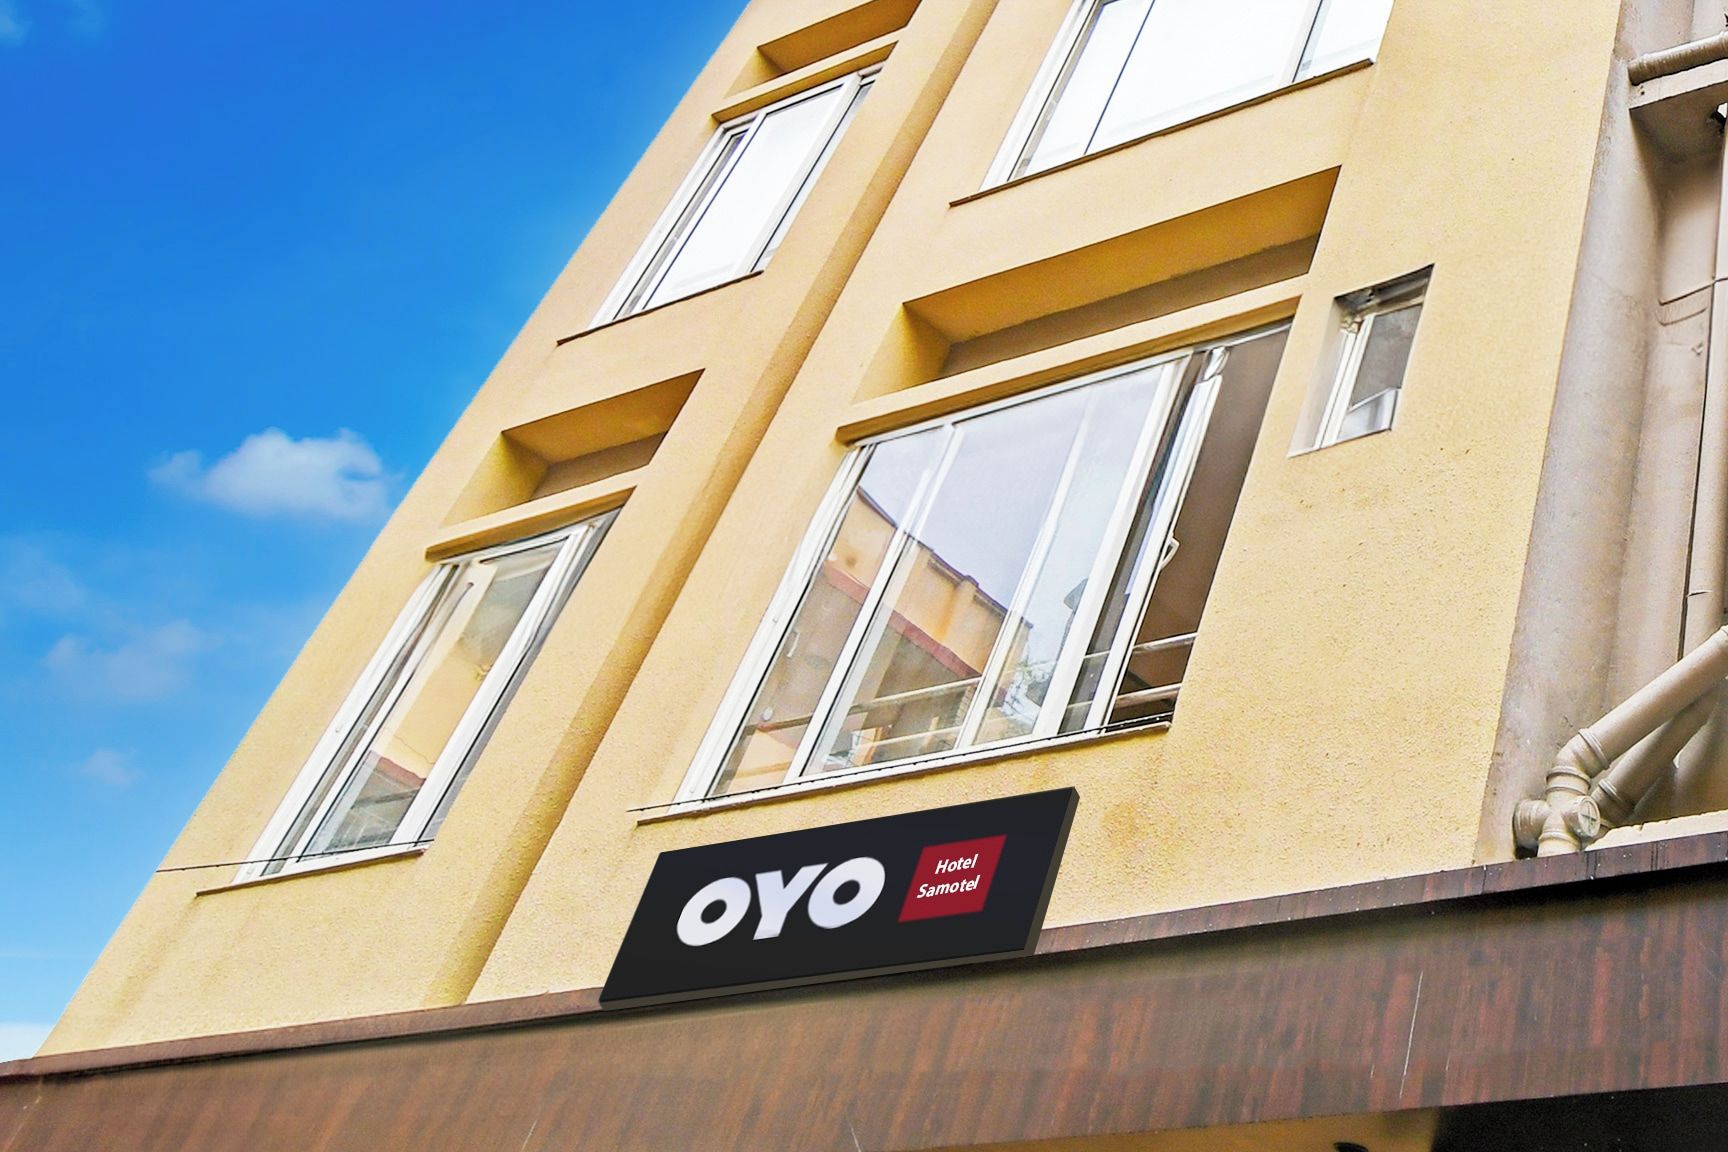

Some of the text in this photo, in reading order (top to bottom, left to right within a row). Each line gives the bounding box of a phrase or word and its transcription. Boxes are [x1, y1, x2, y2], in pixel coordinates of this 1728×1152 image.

[934, 853, 979, 874] Hotel
[916, 874, 981, 898] Samotel
[677, 856, 885, 946] OYO
